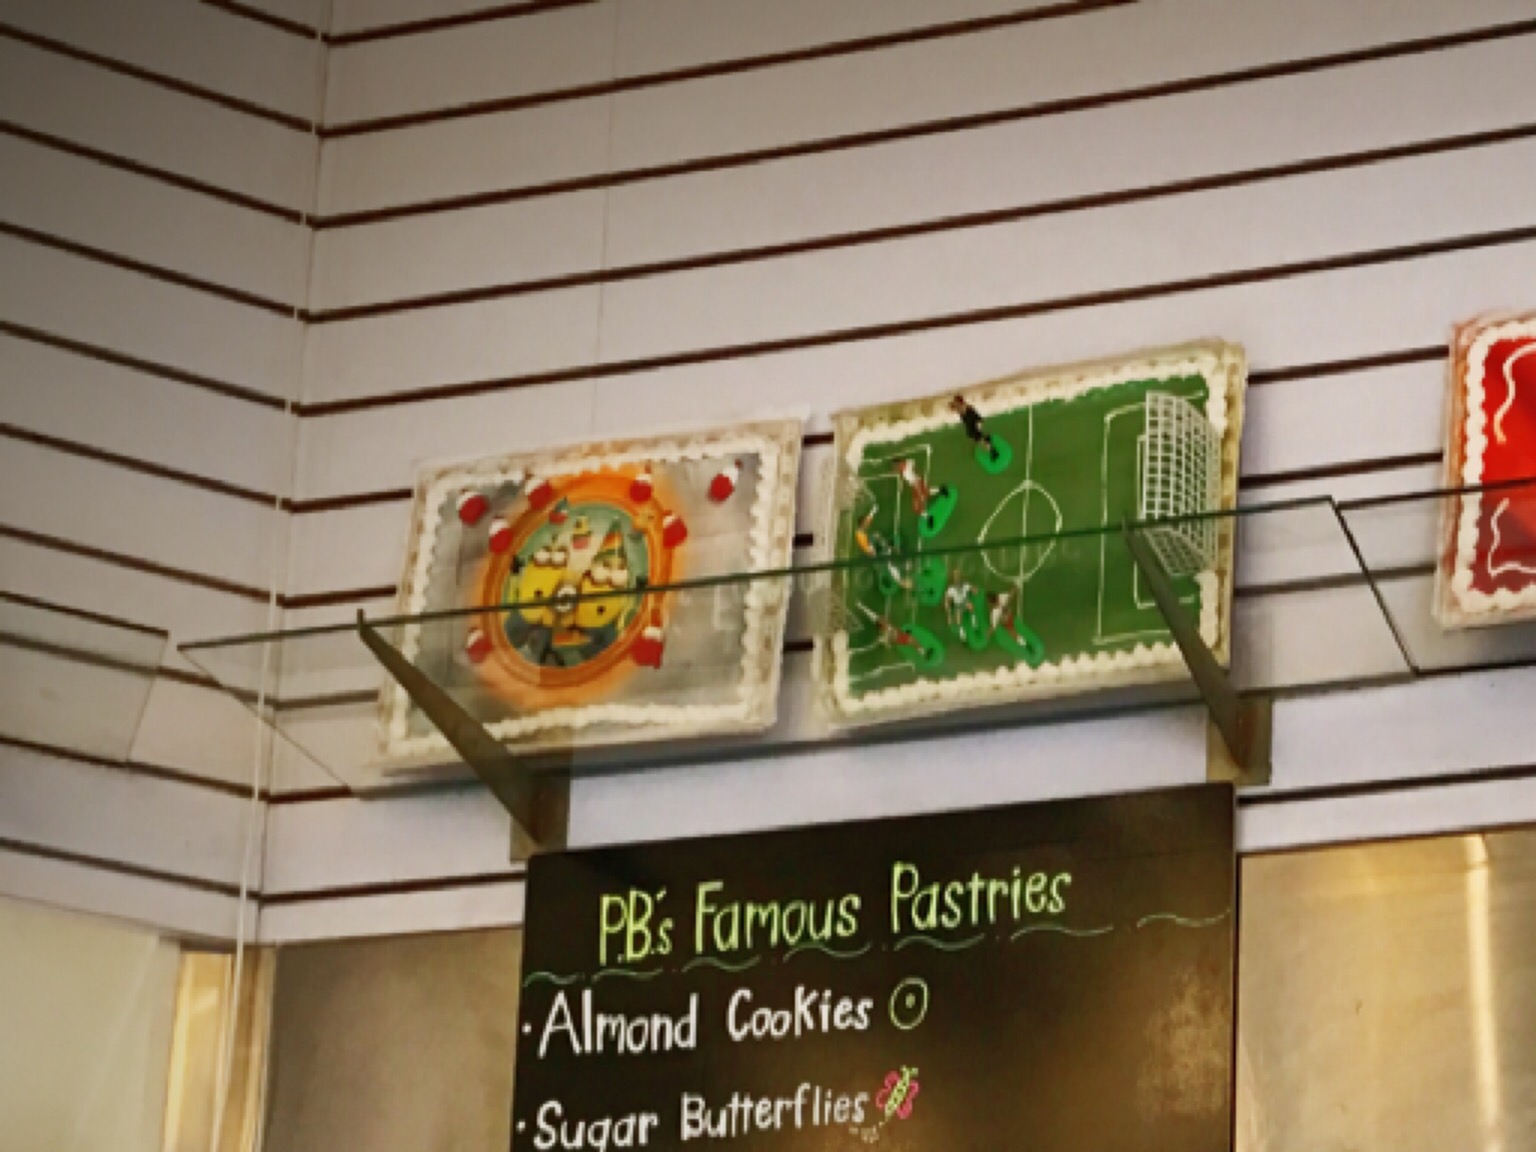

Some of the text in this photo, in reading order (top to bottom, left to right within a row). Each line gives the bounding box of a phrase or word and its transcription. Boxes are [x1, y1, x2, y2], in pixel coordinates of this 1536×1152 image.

[695, 880, 861, 953] Famous
[892, 861, 1072, 933] Pastries
[537, 986, 874, 1058] Almond Cookies
[681, 1086, 869, 1141] Butterflies
